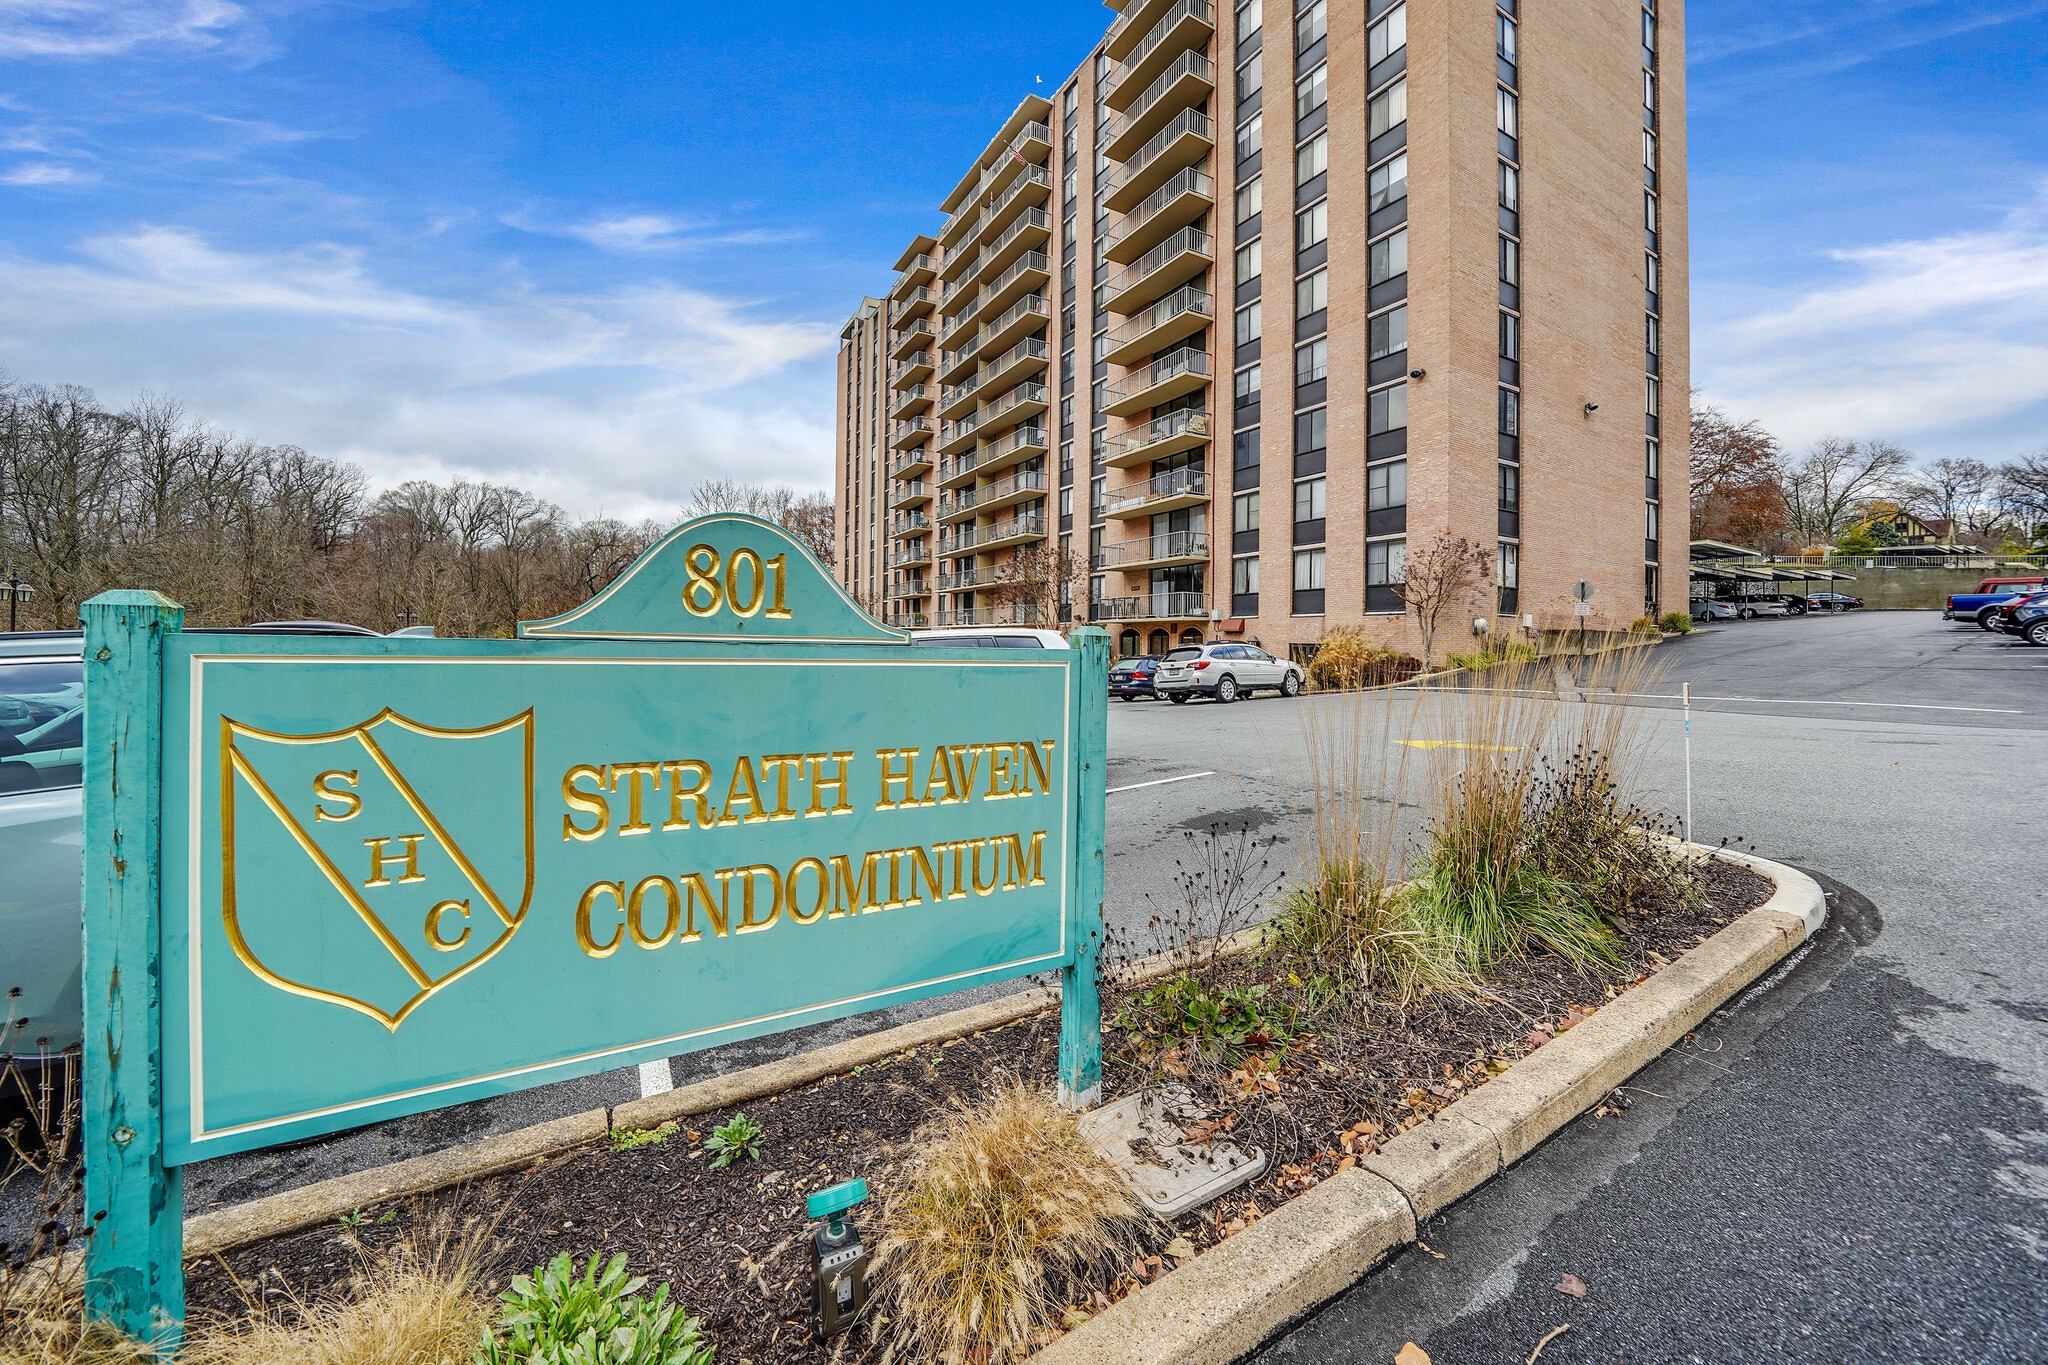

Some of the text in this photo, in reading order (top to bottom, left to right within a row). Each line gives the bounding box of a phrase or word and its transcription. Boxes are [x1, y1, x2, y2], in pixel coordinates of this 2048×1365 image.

[684, 544, 794, 620] 801
[561, 740, 1057, 842] STRATH HAVEN
[313, 770, 472, 953] S H C
[576, 831, 1047, 959] CONDOMINIUM
